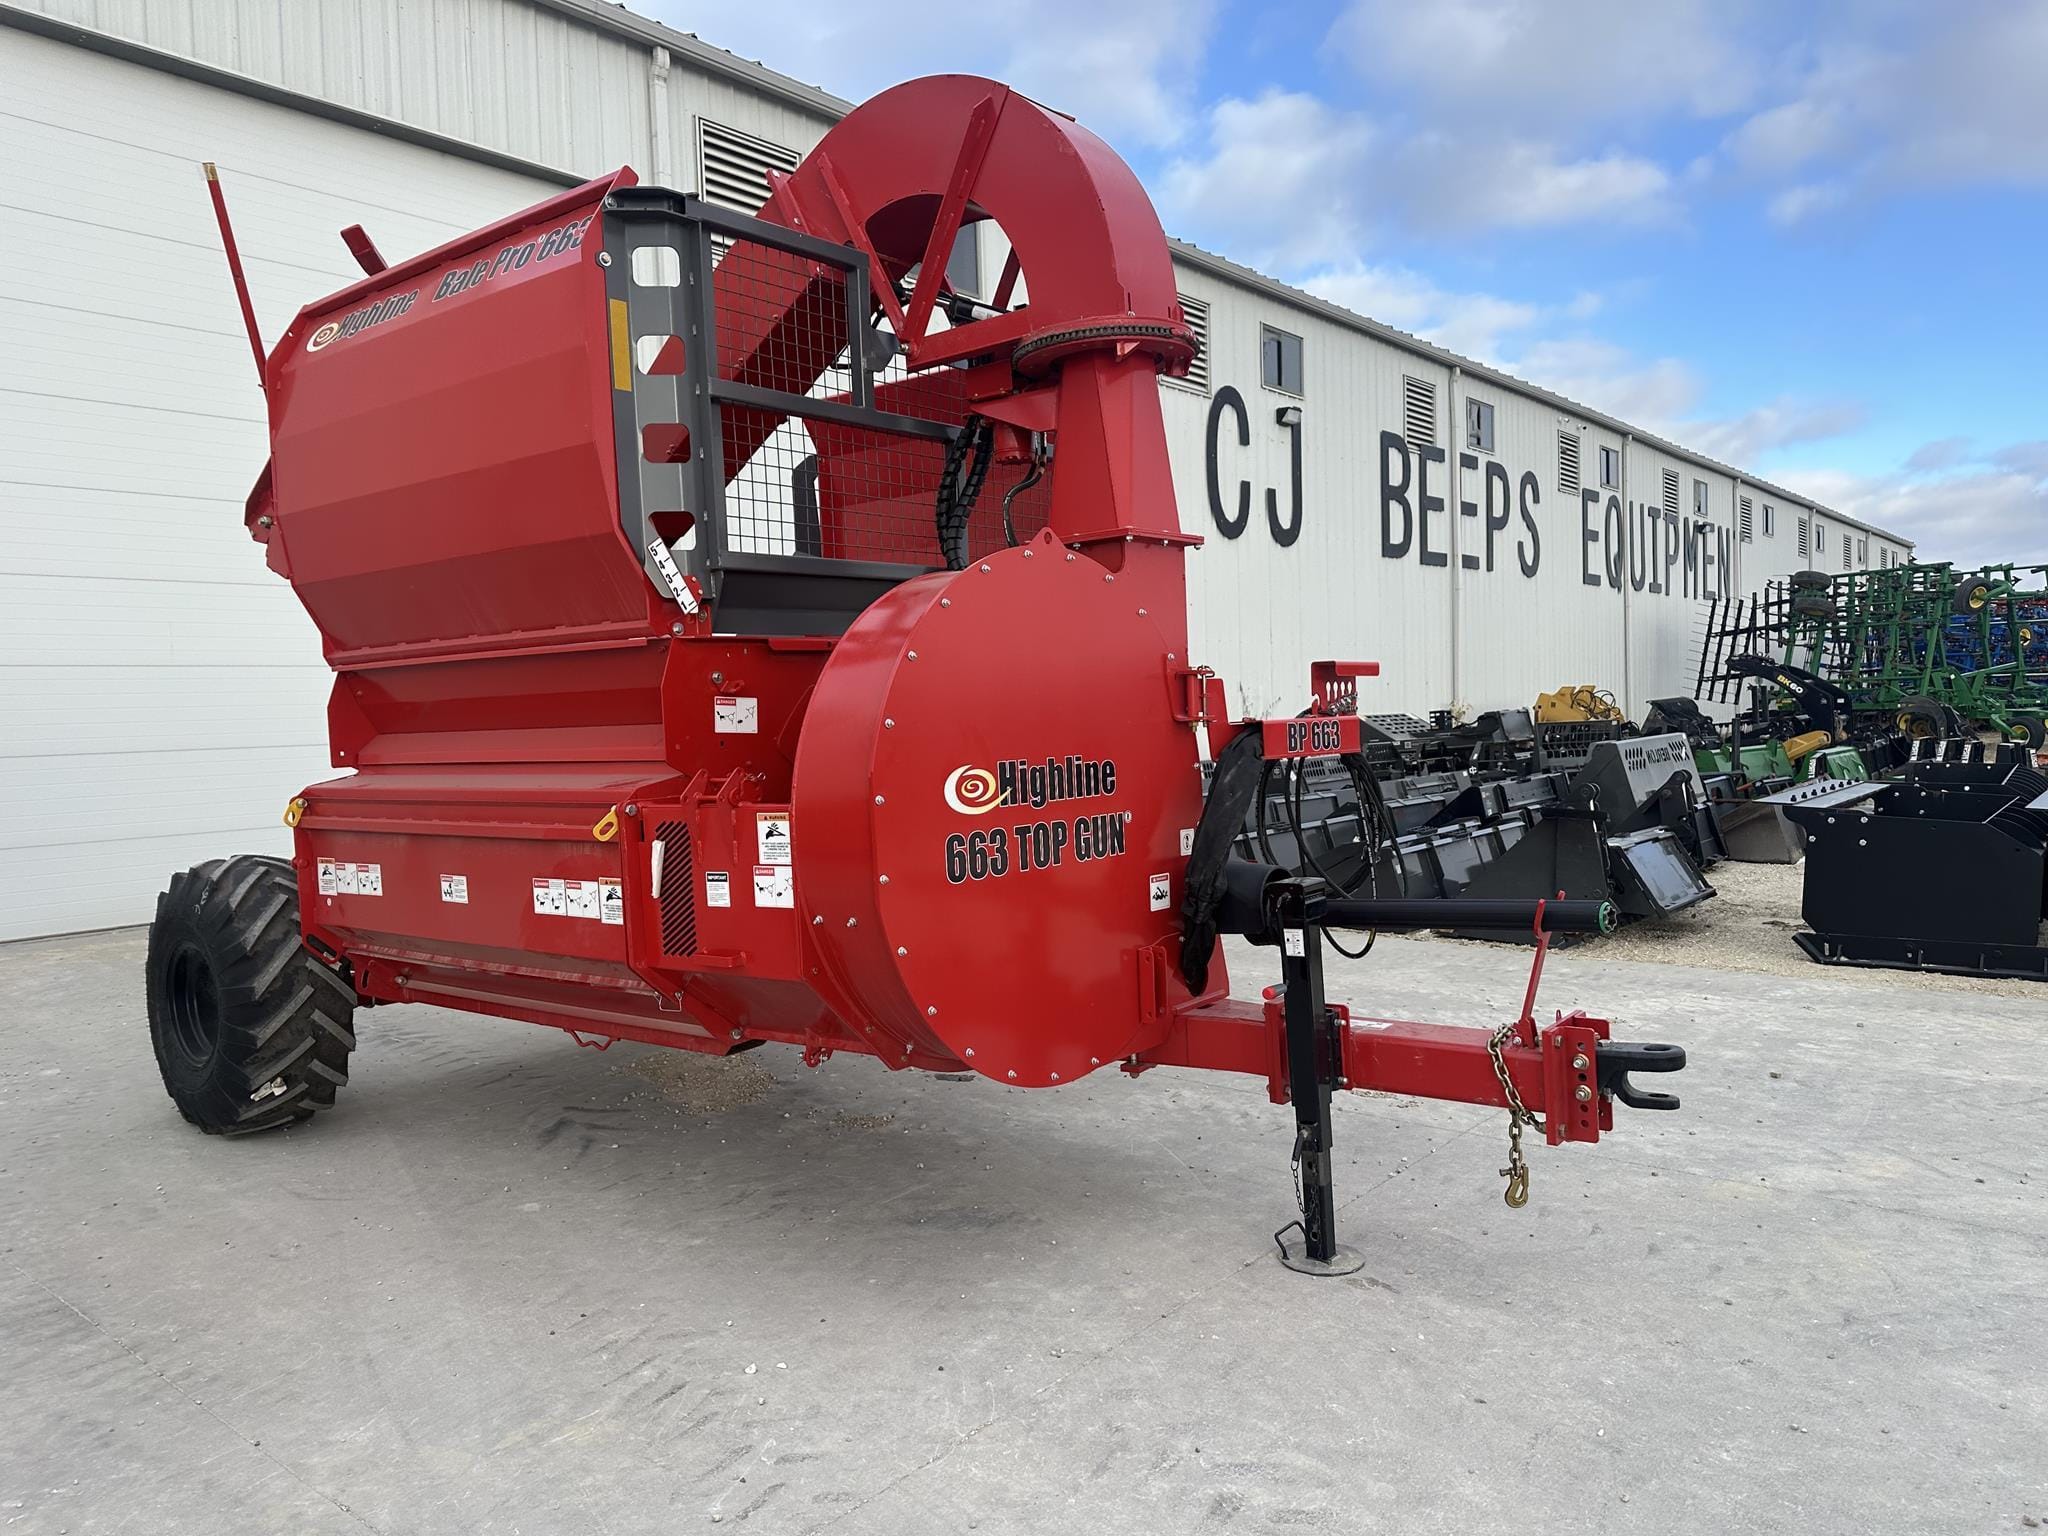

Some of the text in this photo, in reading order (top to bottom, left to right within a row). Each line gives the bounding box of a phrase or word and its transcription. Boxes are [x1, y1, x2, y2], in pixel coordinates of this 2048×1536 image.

[336, 289, 420, 341] Highline
[432, 260, 490, 302] Bale
[1206, 385, 1302, 547] CJ
[1380, 430, 1540, 578] BEEPS
[650, 546, 658, 556] 5
[666, 573, 673, 584] 3
[673, 587, 680, 597] 2
[1287, 720, 1341, 753] BP 663
[997, 755, 1116, 809] Highline
[945, 828, 1009, 884] 663
[1014, 820, 1068, 872] TOP
